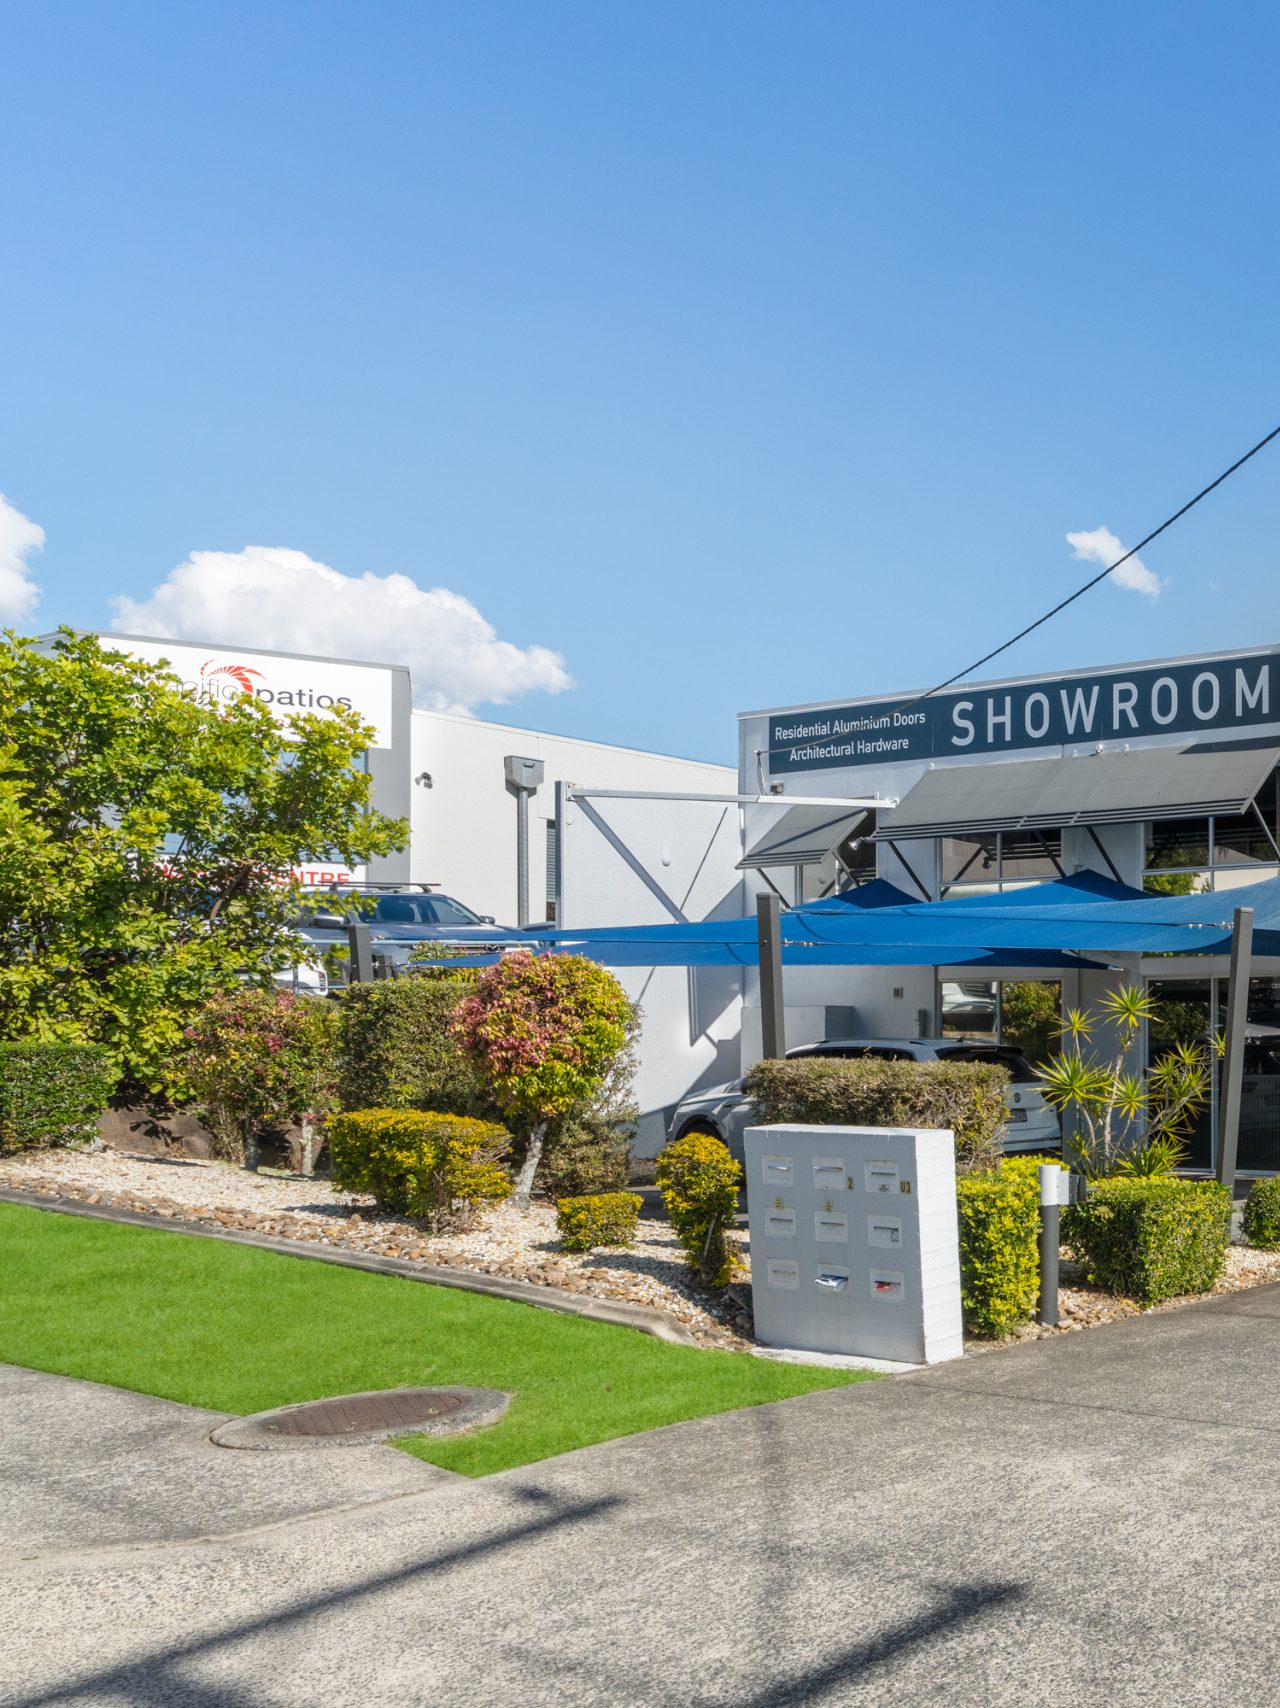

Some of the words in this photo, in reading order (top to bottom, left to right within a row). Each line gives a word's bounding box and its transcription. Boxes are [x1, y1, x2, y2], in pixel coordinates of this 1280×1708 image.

[256, 688, 353, 711] patios
[951, 665, 1270, 746] SHOWROOM
[775, 721, 830, 741] Residential
[832, 716, 890, 734] Aluminium
[894, 712, 926, 727] Doors
[789, 744, 854, 761] Architectural
[857, 737, 909, 754] Hardware
